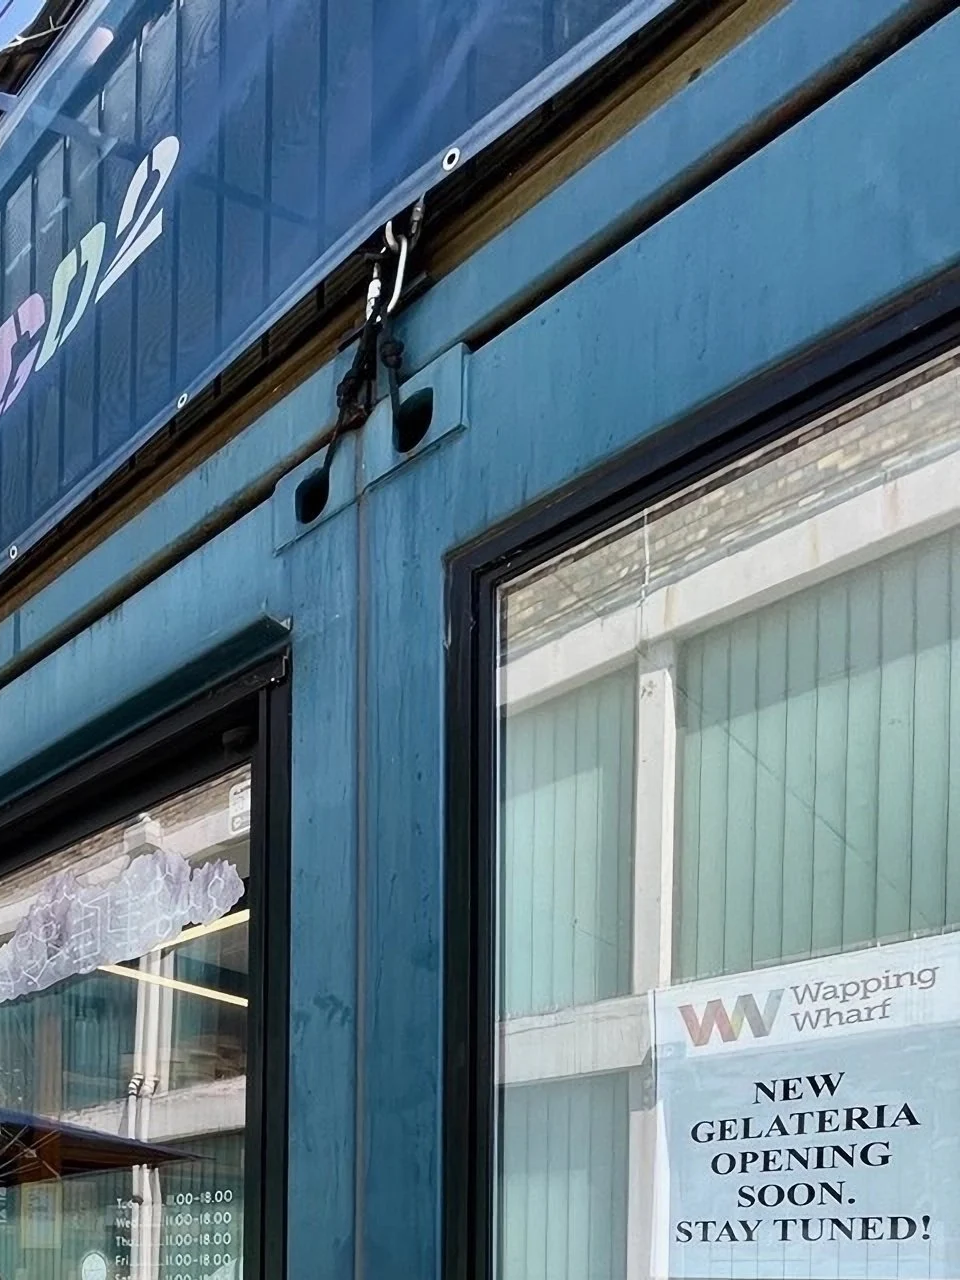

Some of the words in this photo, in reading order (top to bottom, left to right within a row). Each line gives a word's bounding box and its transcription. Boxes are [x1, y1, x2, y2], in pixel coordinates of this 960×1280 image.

[790, 966, 940, 1005] Wapping
[790, 997, 892, 1032] Wharf
[752, 1072, 845, 1104] NEW
[690, 1103, 920, 1143] GELATERIA
[711, 1142, 892, 1175] OPENING
[736, 1181, 856, 1208] SOON.
[675, 1220, 763, 1243] STAY
[773, 1215, 932, 1242] TUNED!
